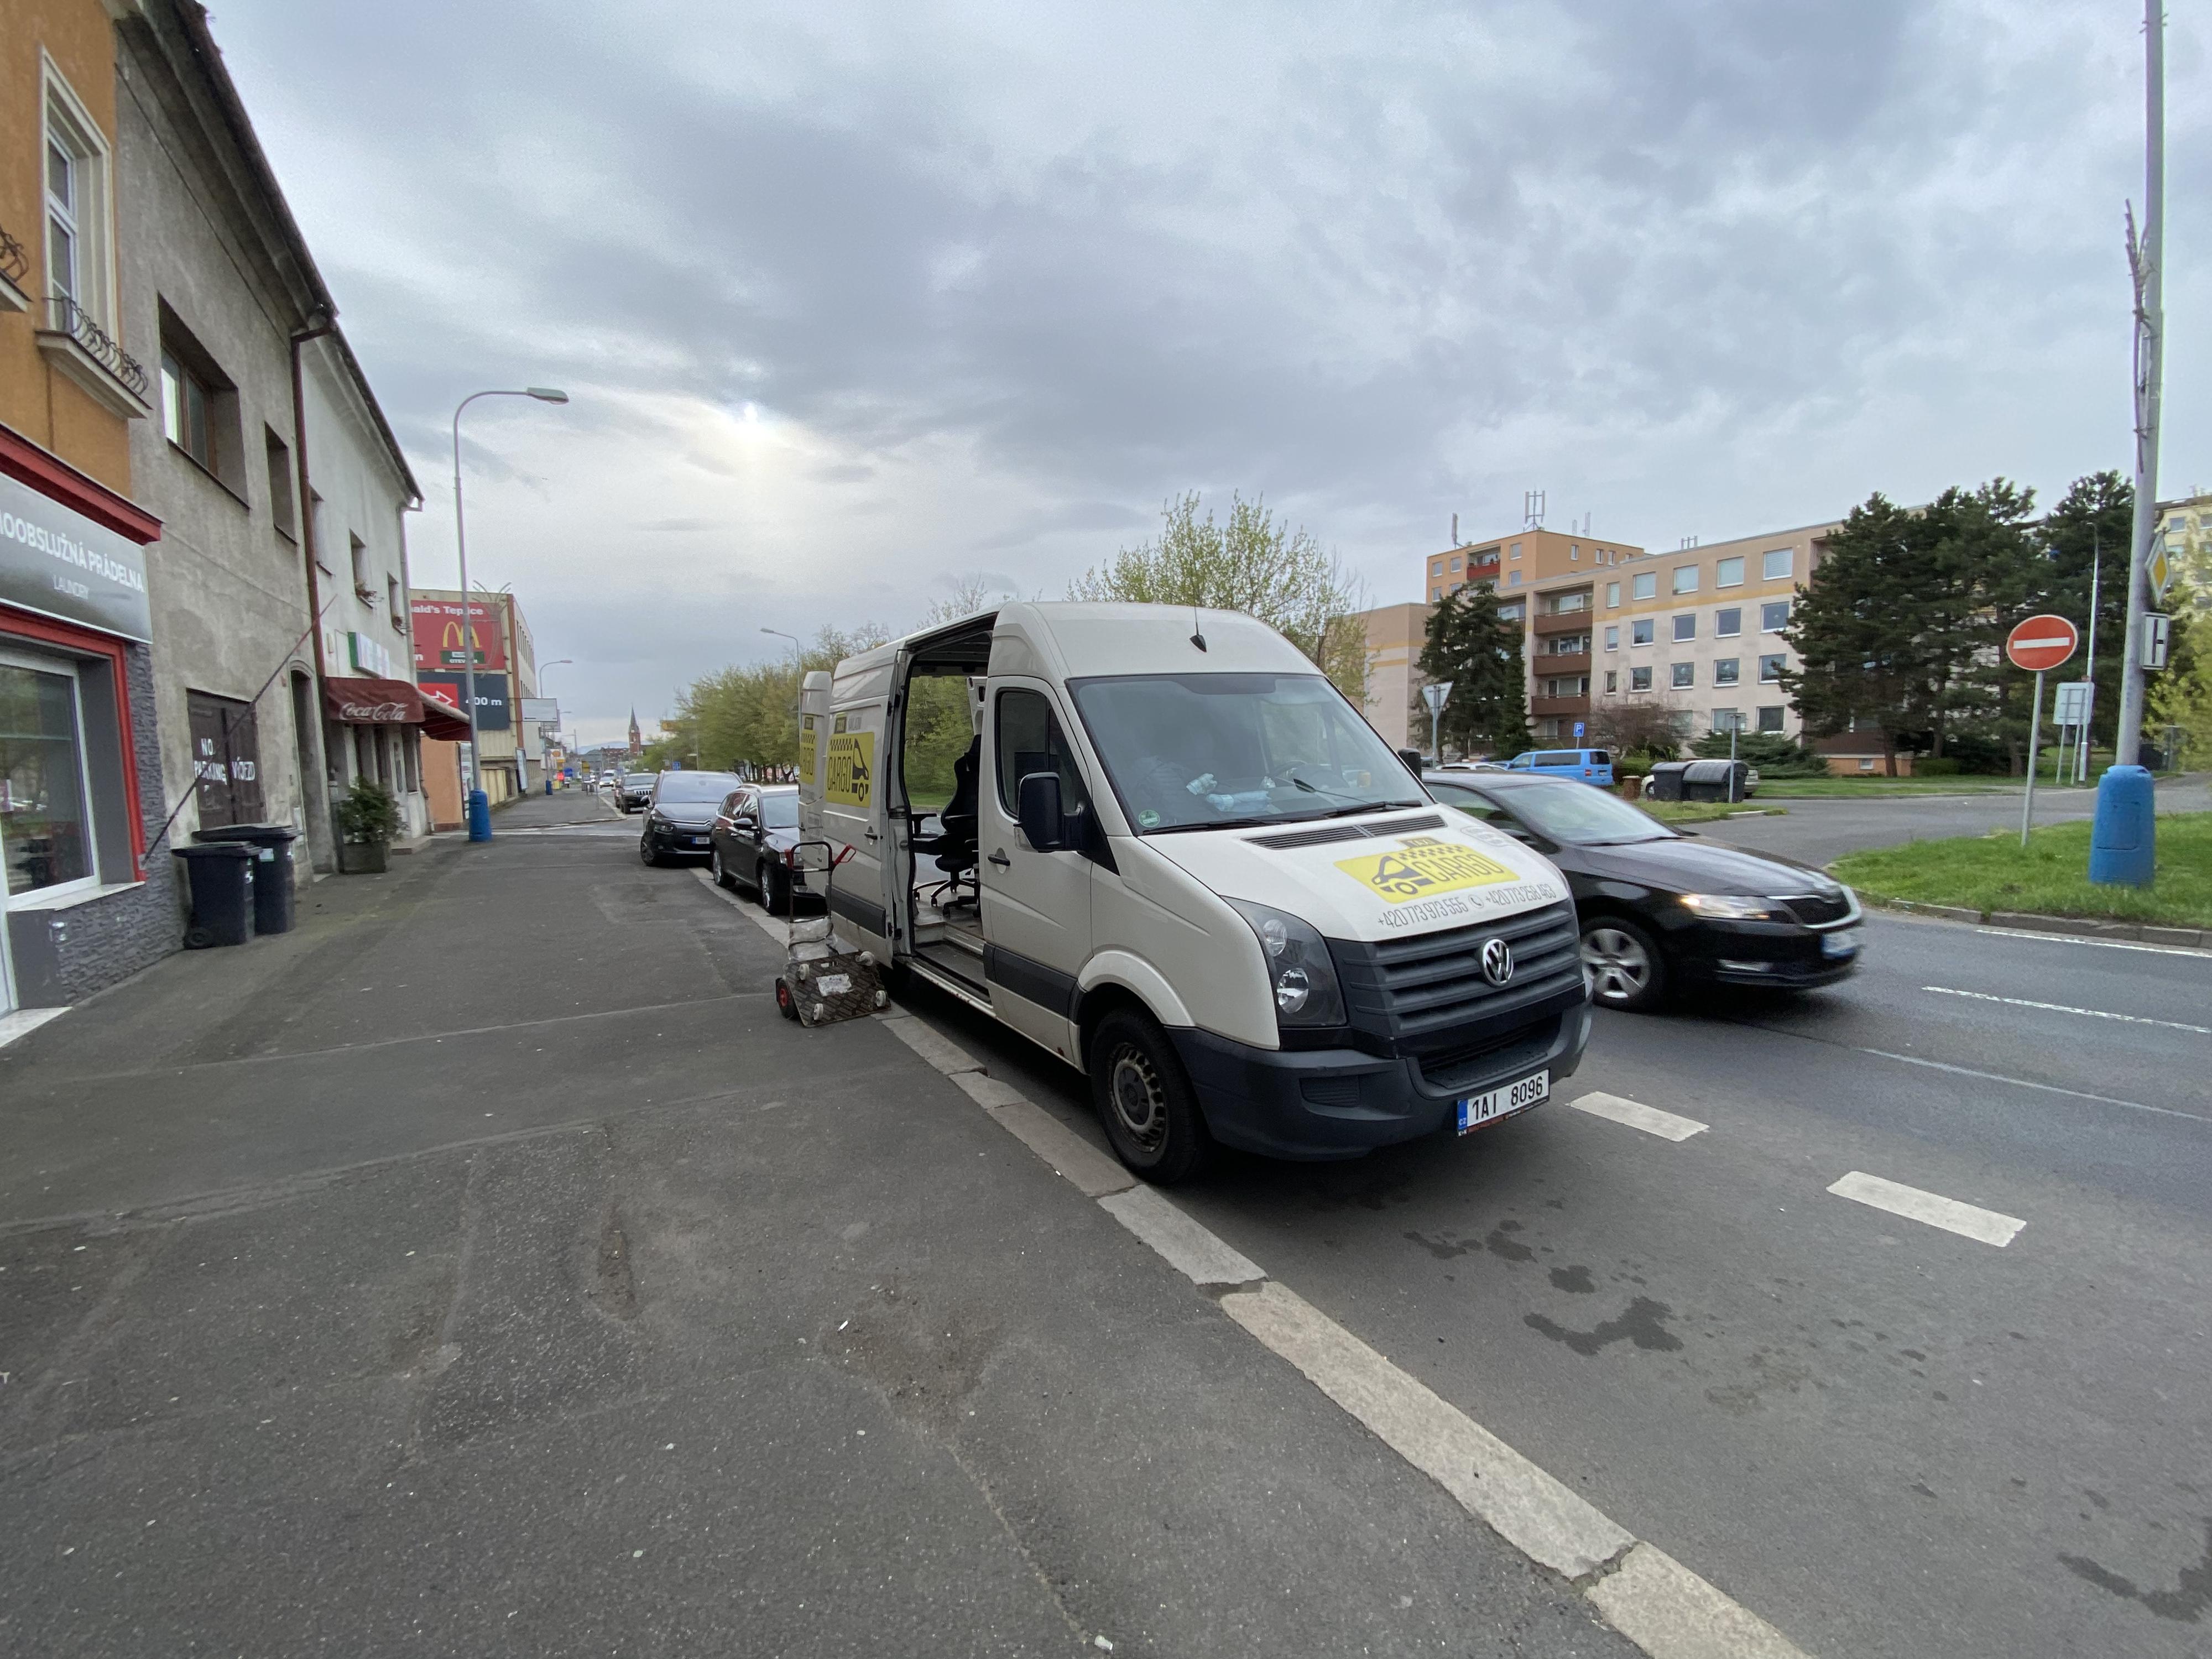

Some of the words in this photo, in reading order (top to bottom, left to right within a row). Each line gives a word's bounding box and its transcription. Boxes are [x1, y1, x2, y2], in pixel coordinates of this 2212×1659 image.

[87, 550, 145, 593] PRÁDELNA
[53, 574, 90, 599] LAUNDRY
[443, 606, 484, 616] Tepice
[465, 697, 488, 706] 00
[827, 756, 852, 792] CARGO
[1406, 838, 1437, 847] TAXI
[1412, 853, 1505, 881] CARGO
[1485, 890, 1511, 906] +420
[1503, 888, 1526, 903] 773
[1378, 909, 1408, 928] +420
[1402, 905, 1428, 924] 773
[1422, 901, 1448, 919] 973
[1442, 897, 1469, 914] 555
[1472, 1093, 1497, 1120] 1AI
[1511, 1076, 1543, 1106] 8096
[1458, 1117, 1467, 1126] CZ
